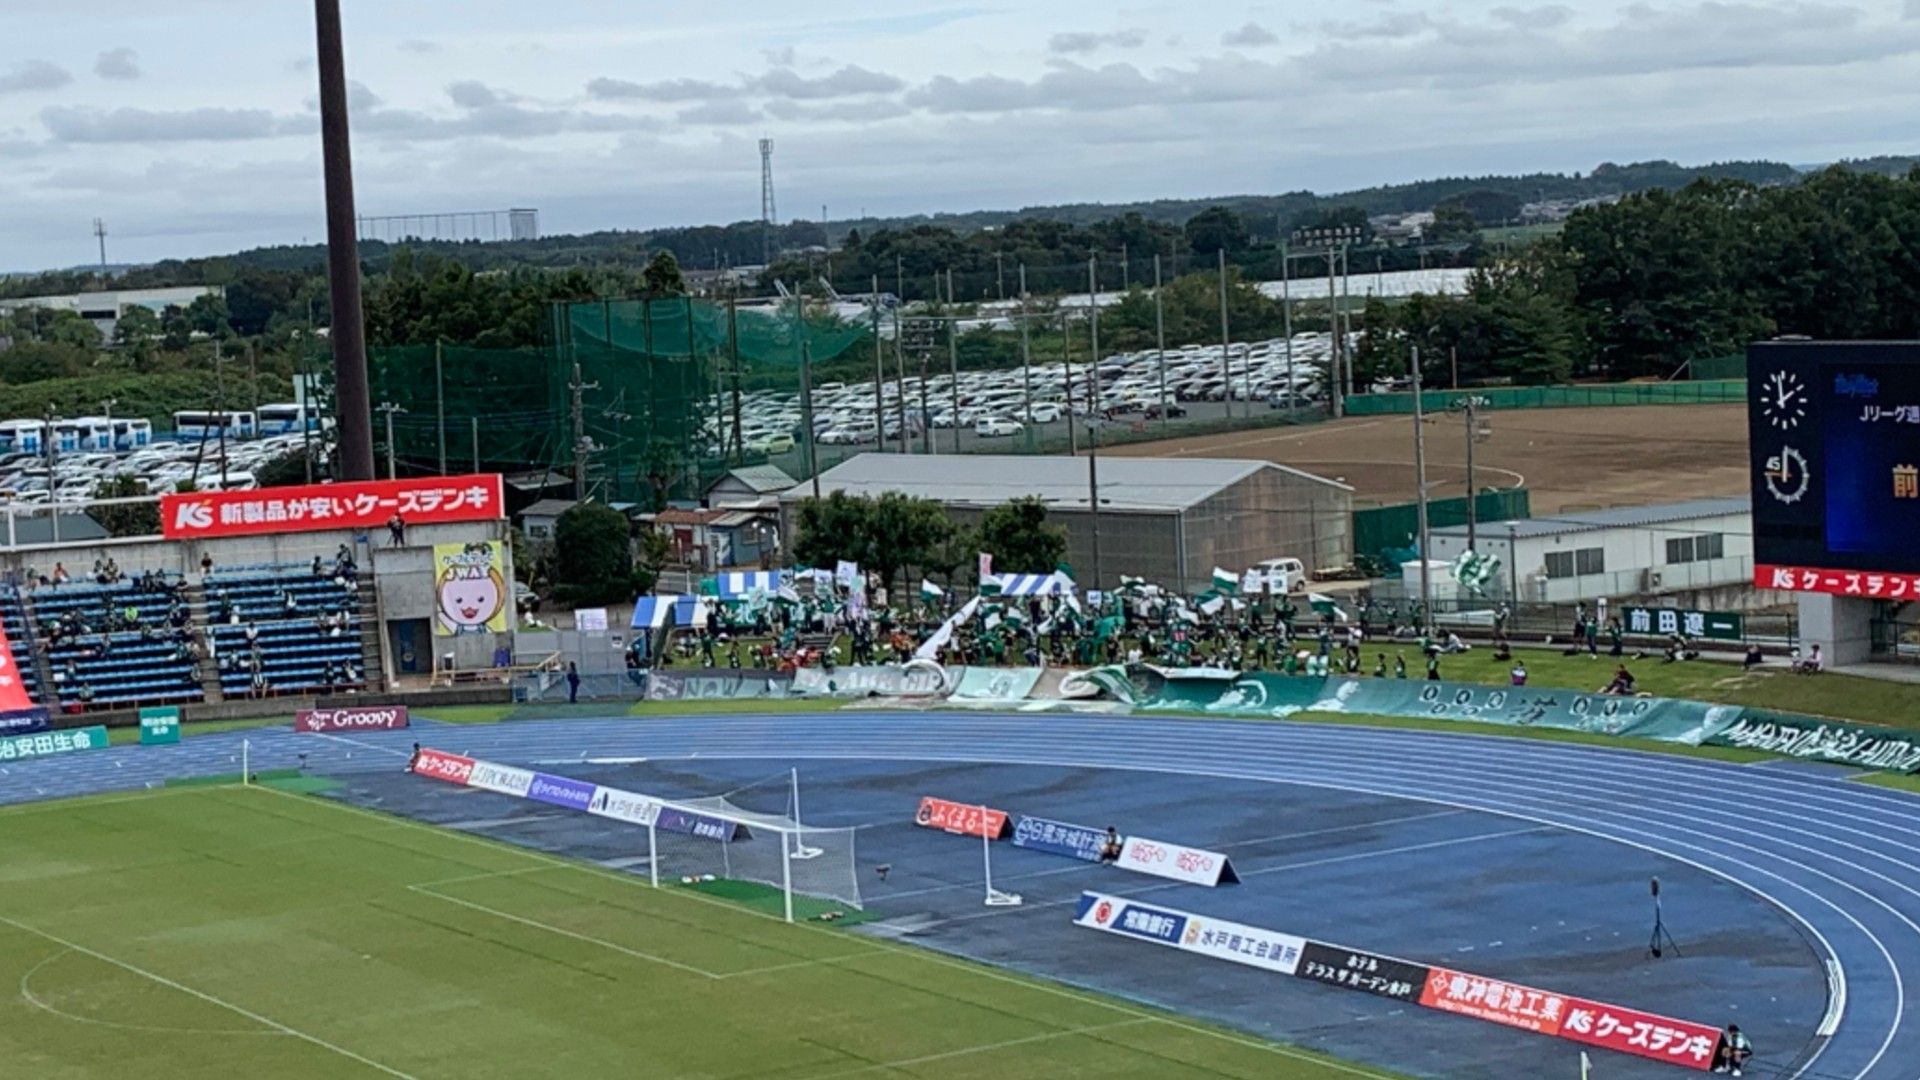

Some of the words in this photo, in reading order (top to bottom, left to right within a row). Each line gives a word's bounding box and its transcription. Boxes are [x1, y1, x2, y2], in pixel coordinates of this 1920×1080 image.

[1892, 463, 1919, 498] 前
[220, 486, 489, 525] 新製品が安いケーズデンキ
[446, 566, 491, 579] JWAY
[332, 710, 397, 728] Groovy
[1202, 927, 1298, 965] 水戸商工会議所
[1347, 955, 1378, 971] ホテル
[1595, 1013, 1713, 1061] ケーズデンキ
